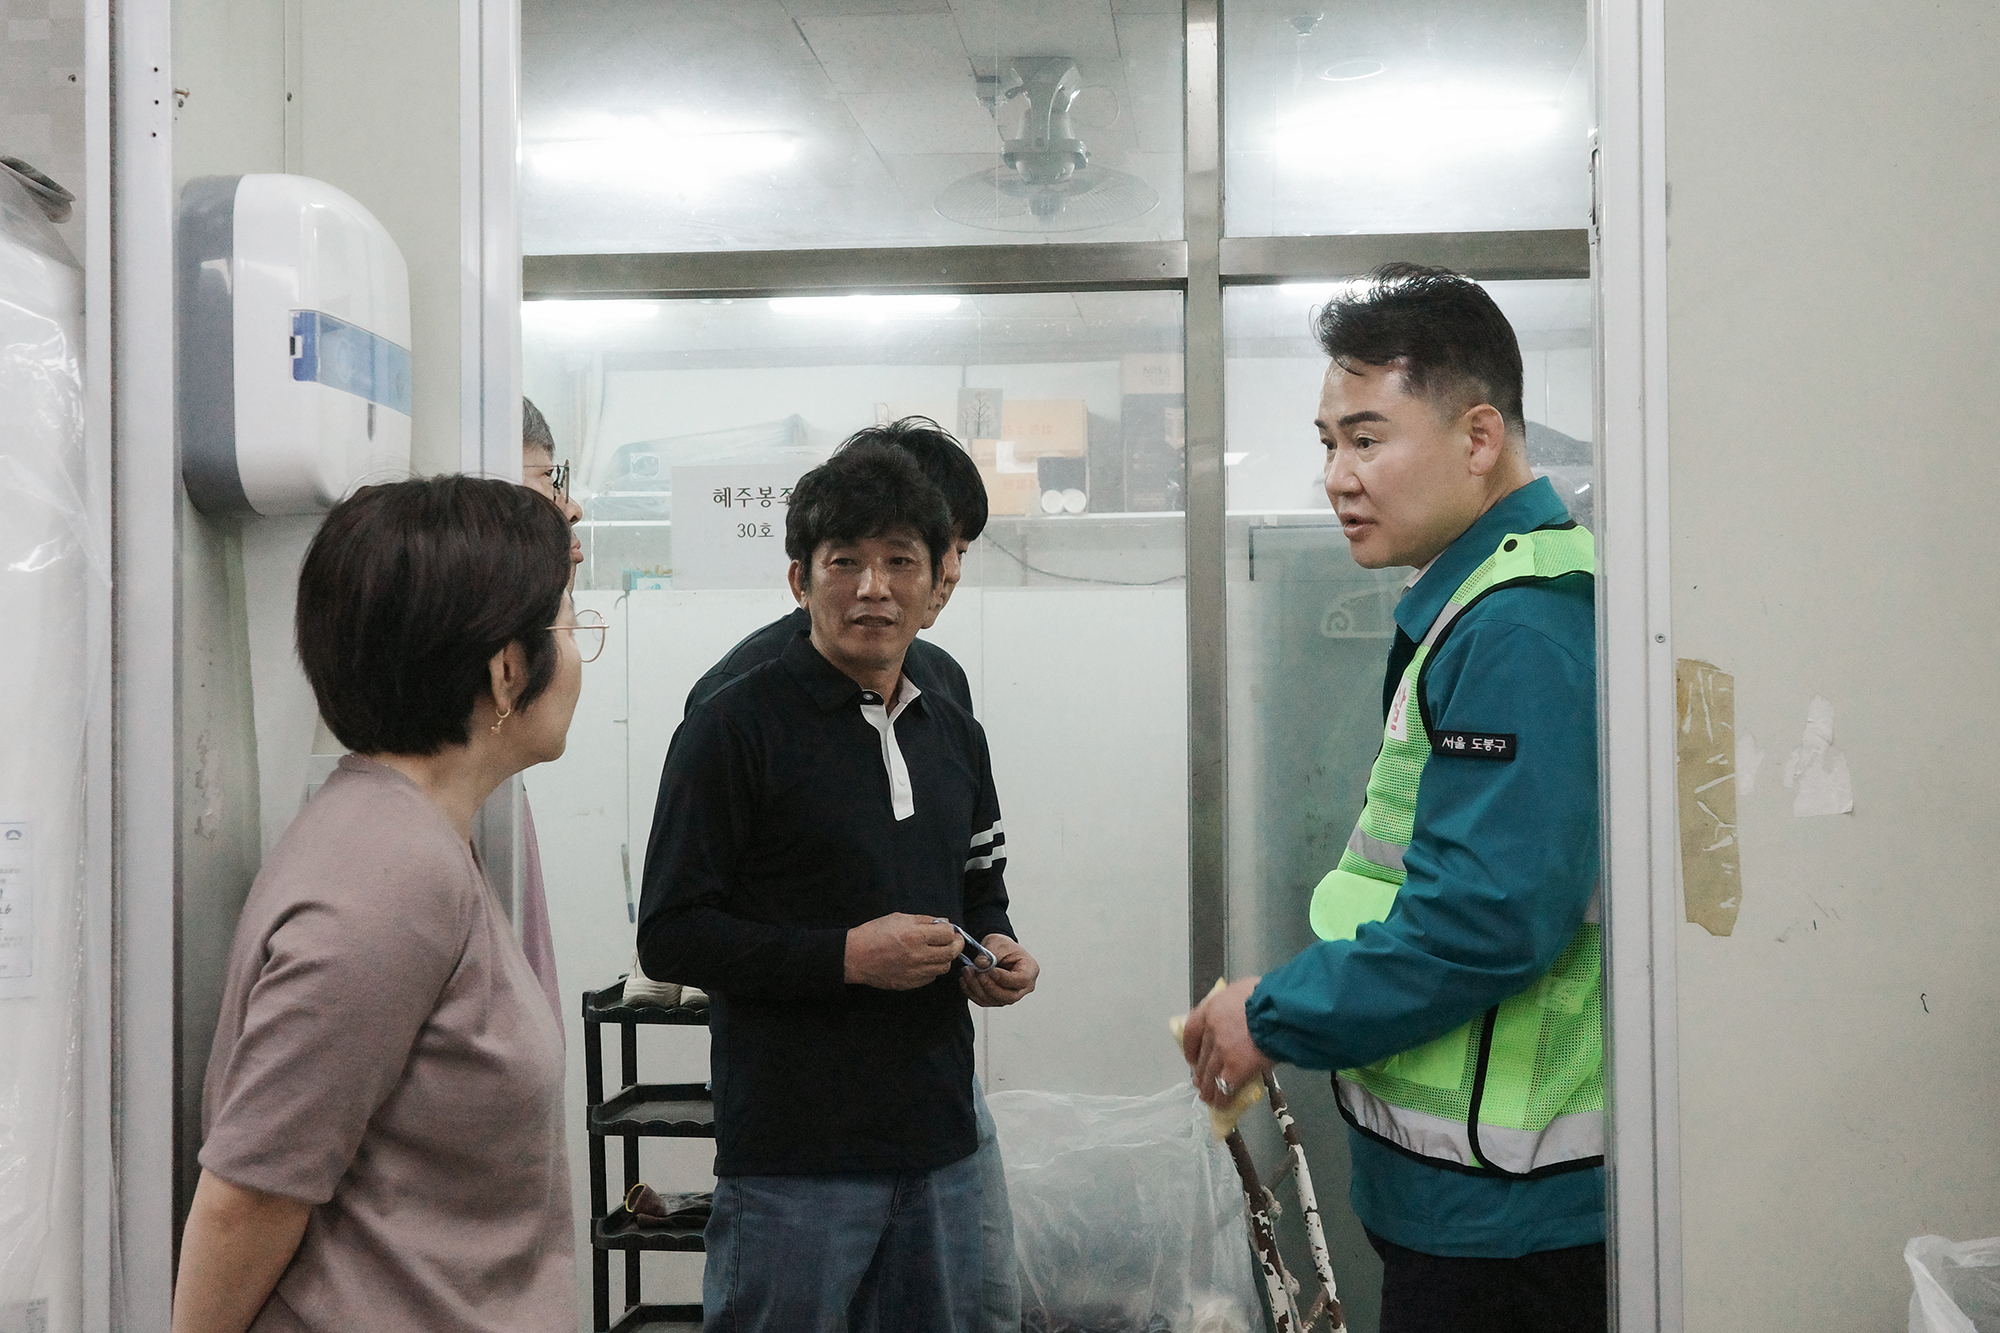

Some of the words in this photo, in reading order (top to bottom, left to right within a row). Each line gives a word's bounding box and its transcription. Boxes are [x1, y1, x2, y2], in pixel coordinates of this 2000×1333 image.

[737, 522, 774, 538] 30호
[1441, 735, 1466, 750] 서울
[1471, 737, 1507, 753] 도봉구
